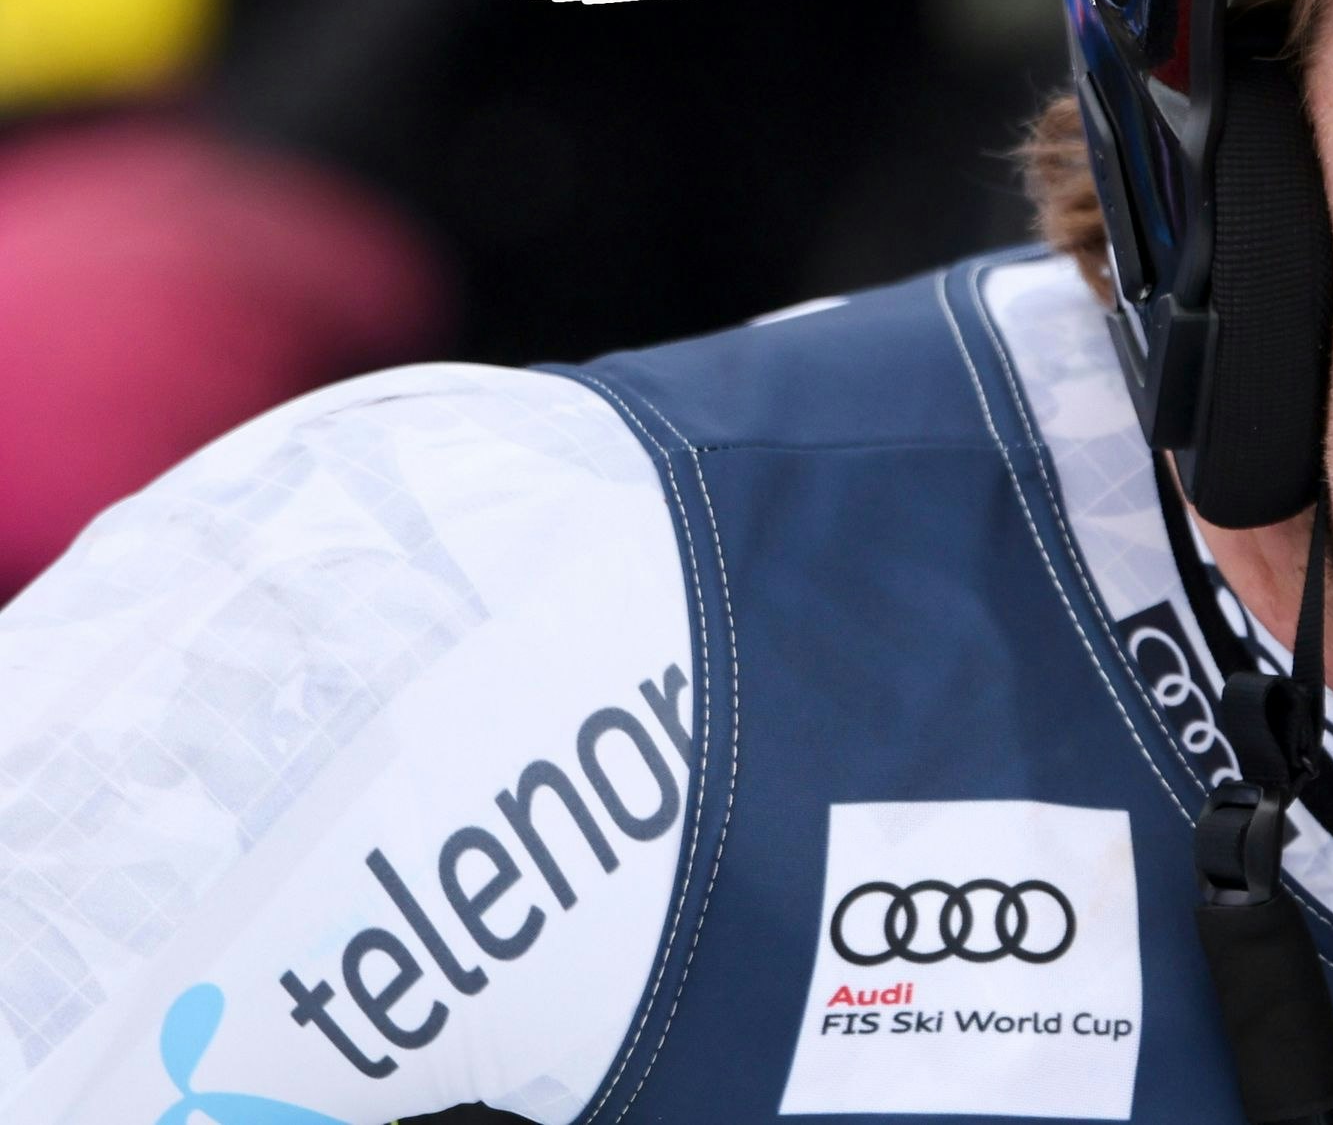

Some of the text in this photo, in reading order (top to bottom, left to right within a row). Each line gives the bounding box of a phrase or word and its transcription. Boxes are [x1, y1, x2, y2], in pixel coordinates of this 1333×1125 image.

[278, 662, 693, 1079] telenor
[826, 982, 914, 1008] Audi
[820, 1010, 1134, 1042] FIS Ski World Cup
